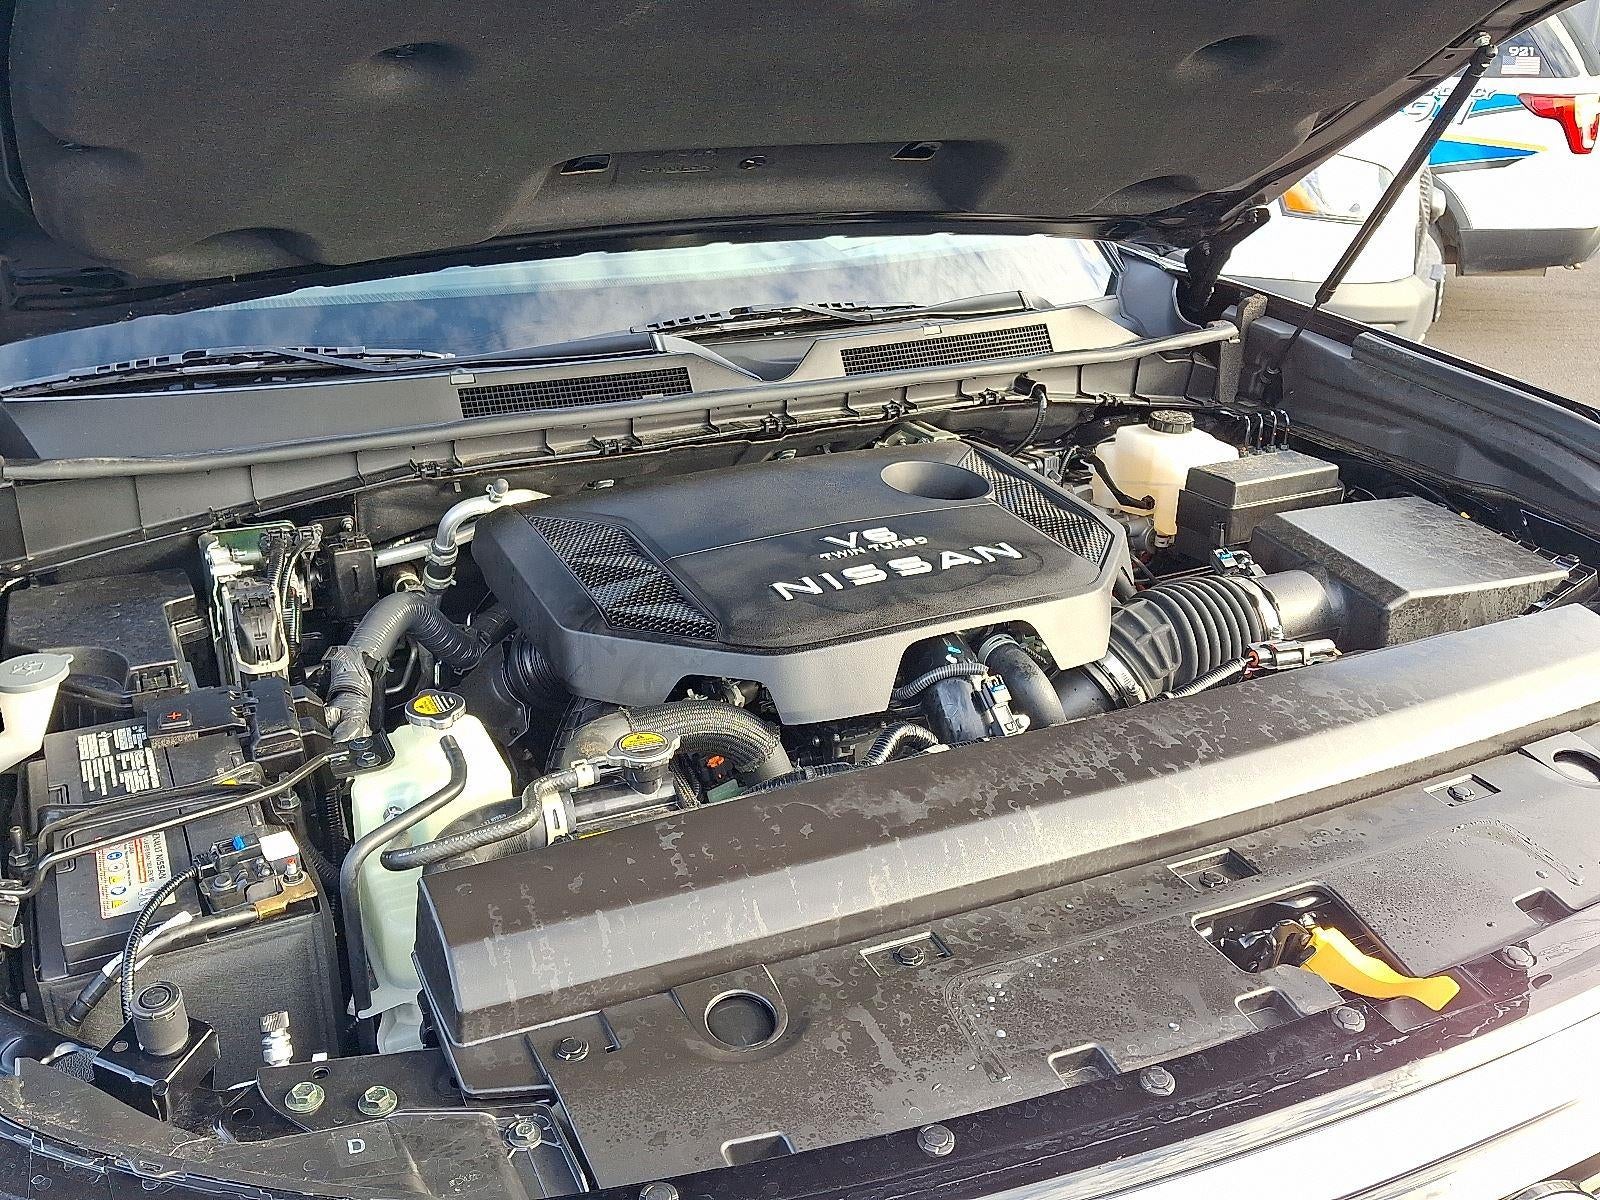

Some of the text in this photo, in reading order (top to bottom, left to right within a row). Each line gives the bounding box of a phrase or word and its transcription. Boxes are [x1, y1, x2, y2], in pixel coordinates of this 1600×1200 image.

[1508, 46, 1535, 57] 921
[819, 526, 898, 549] V6
[819, 536, 928, 560] TWIN TURBO
[768, 541, 1024, 601] NISSAN
[347, 1138, 366, 1155] D
